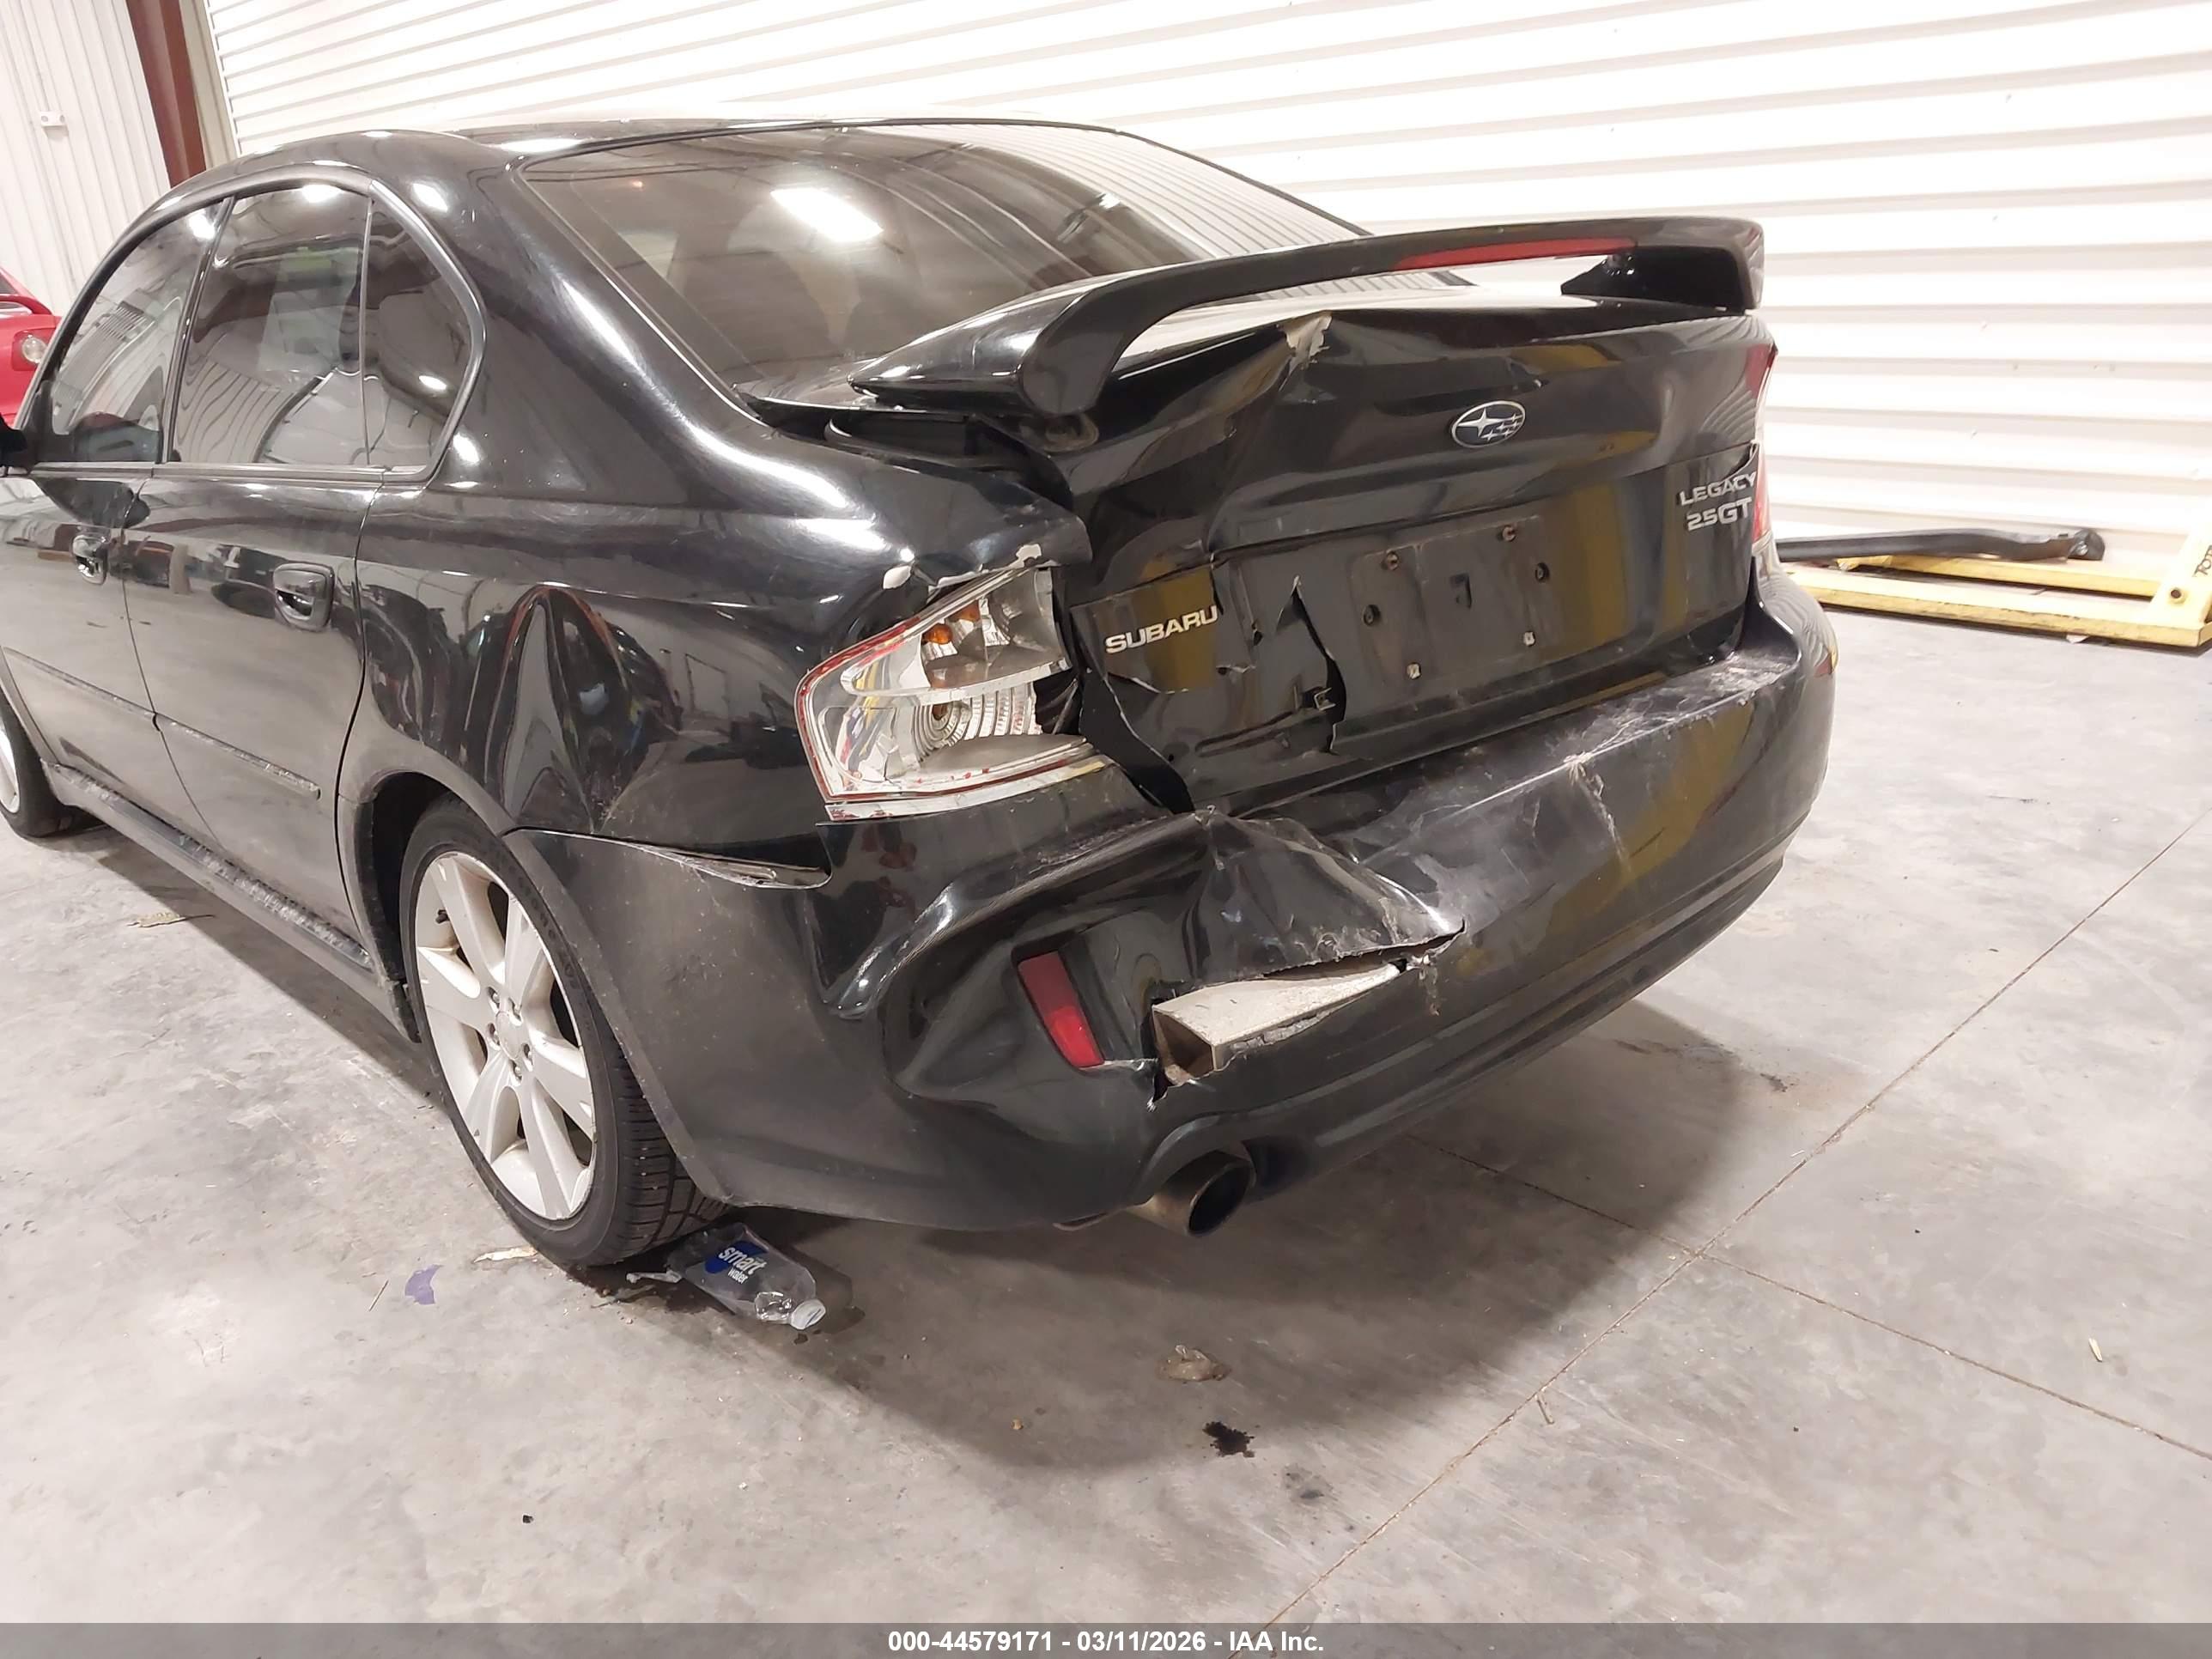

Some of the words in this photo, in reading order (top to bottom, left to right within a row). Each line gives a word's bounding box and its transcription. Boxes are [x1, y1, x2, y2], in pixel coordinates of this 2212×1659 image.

[1679, 471, 1757, 506] LEGACY
[1105, 605, 1218, 653] SUBARU
[718, 1247, 767, 1275] smart
[727, 1267, 749, 1284] water
